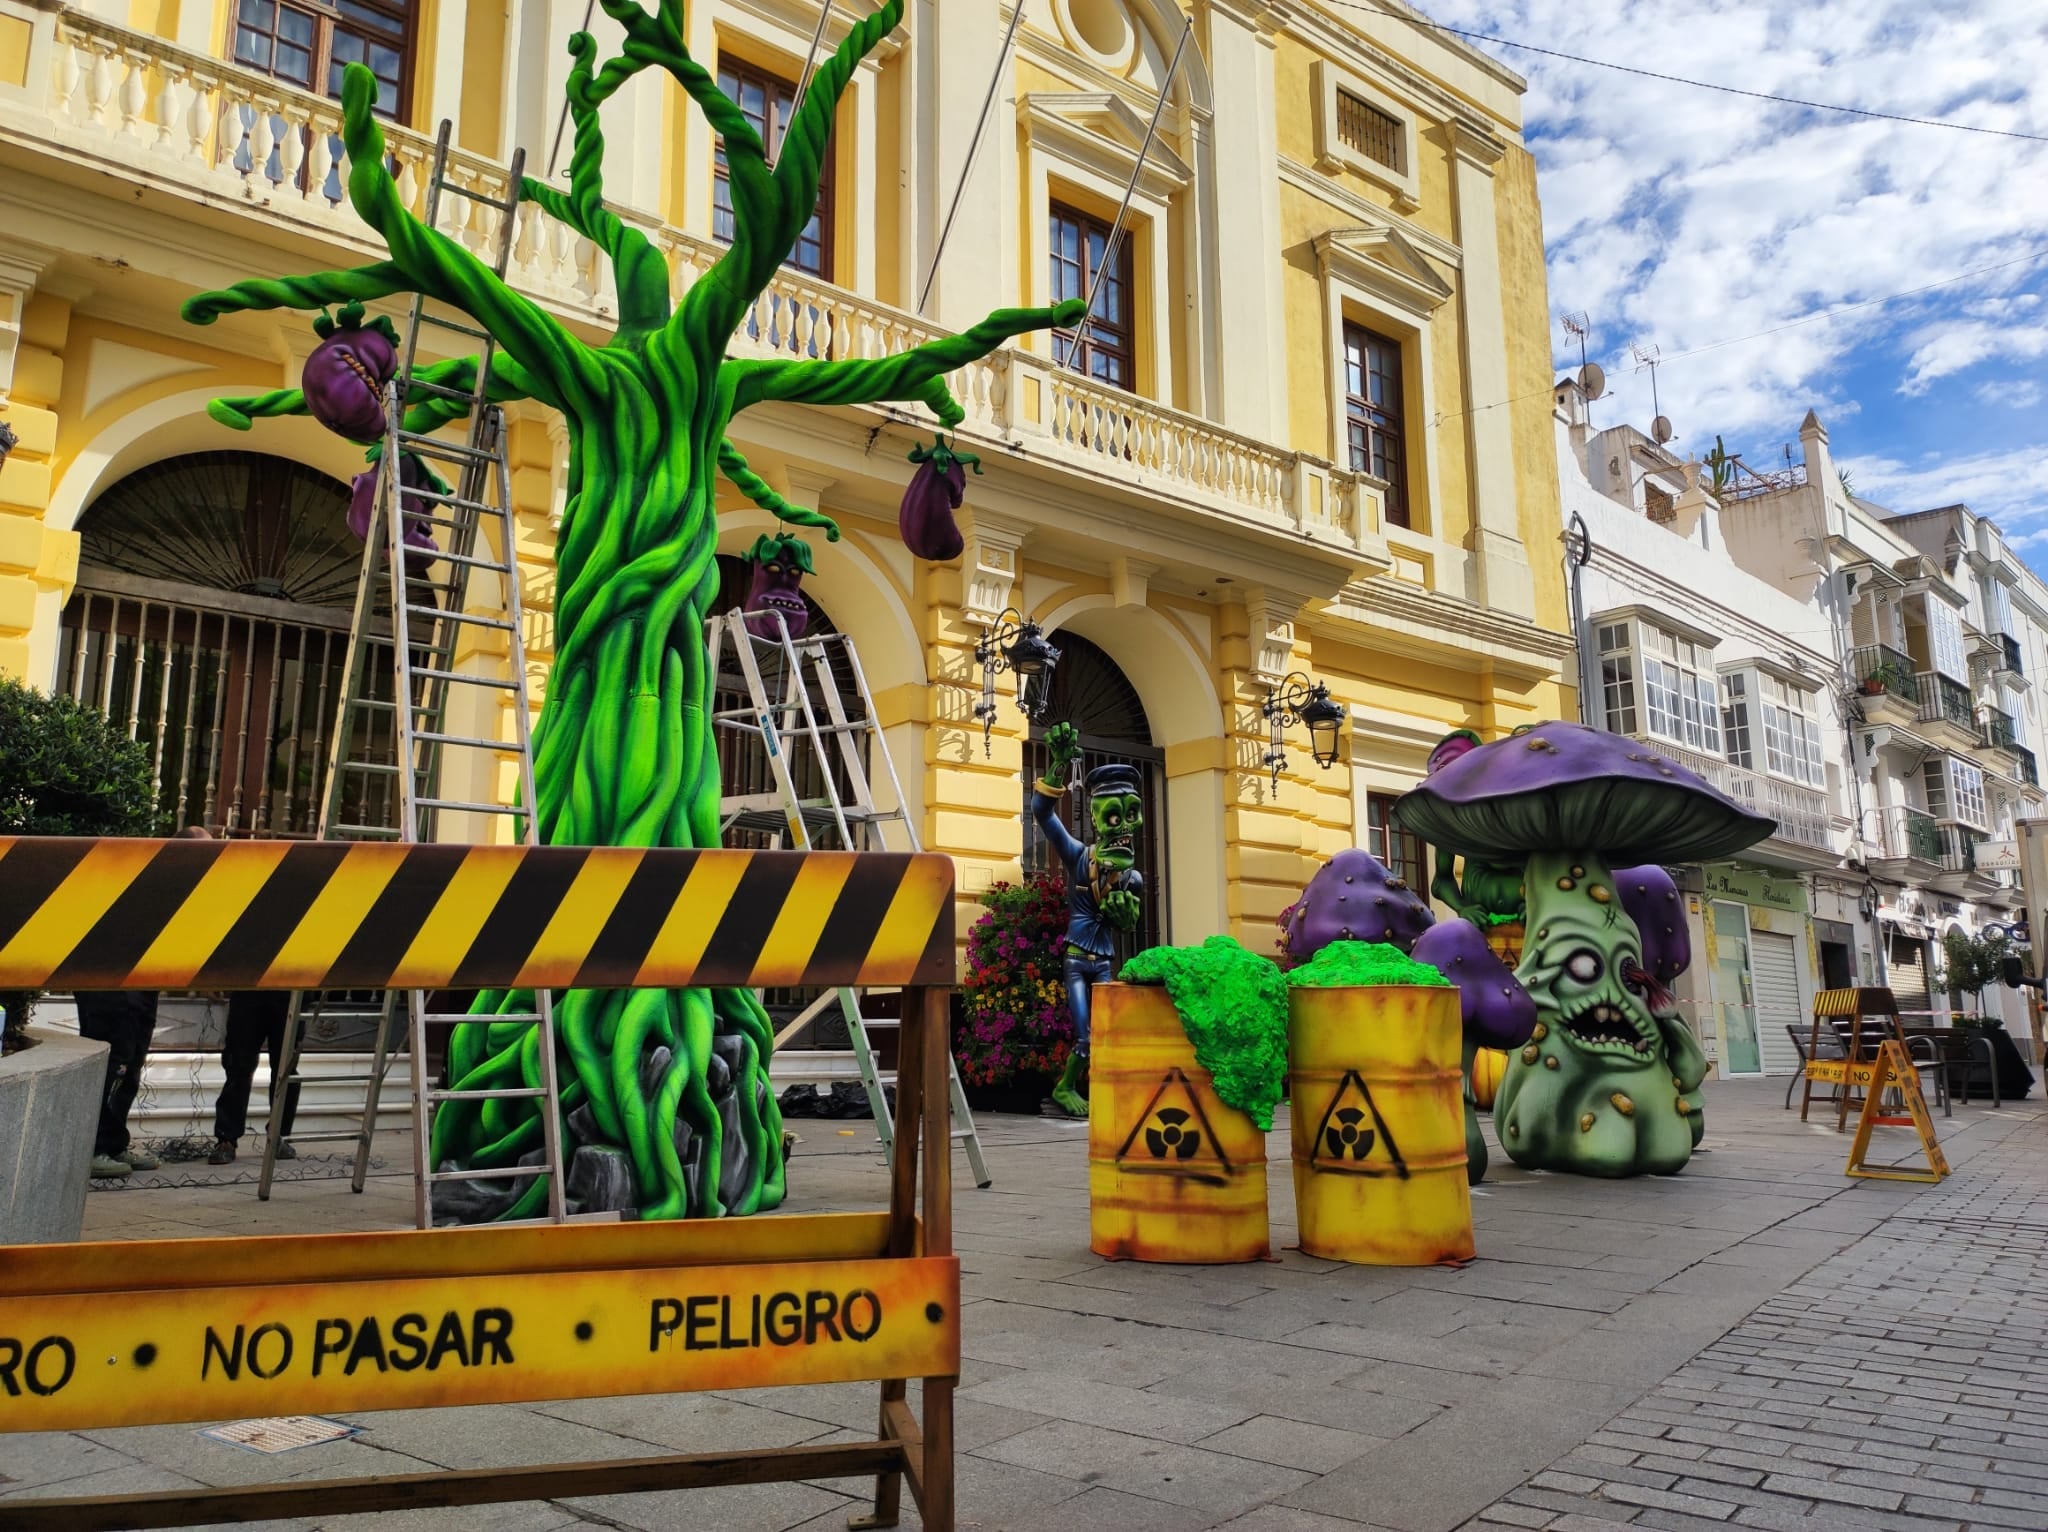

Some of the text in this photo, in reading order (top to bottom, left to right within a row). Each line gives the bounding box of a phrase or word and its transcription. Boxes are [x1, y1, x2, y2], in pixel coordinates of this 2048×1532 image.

[1853, 1071, 1870, 1082] NO
[201, 1322, 294, 1381] NO
[312, 1307, 516, 1377] PASAR
[649, 1288, 882, 1352] PELIGRO
